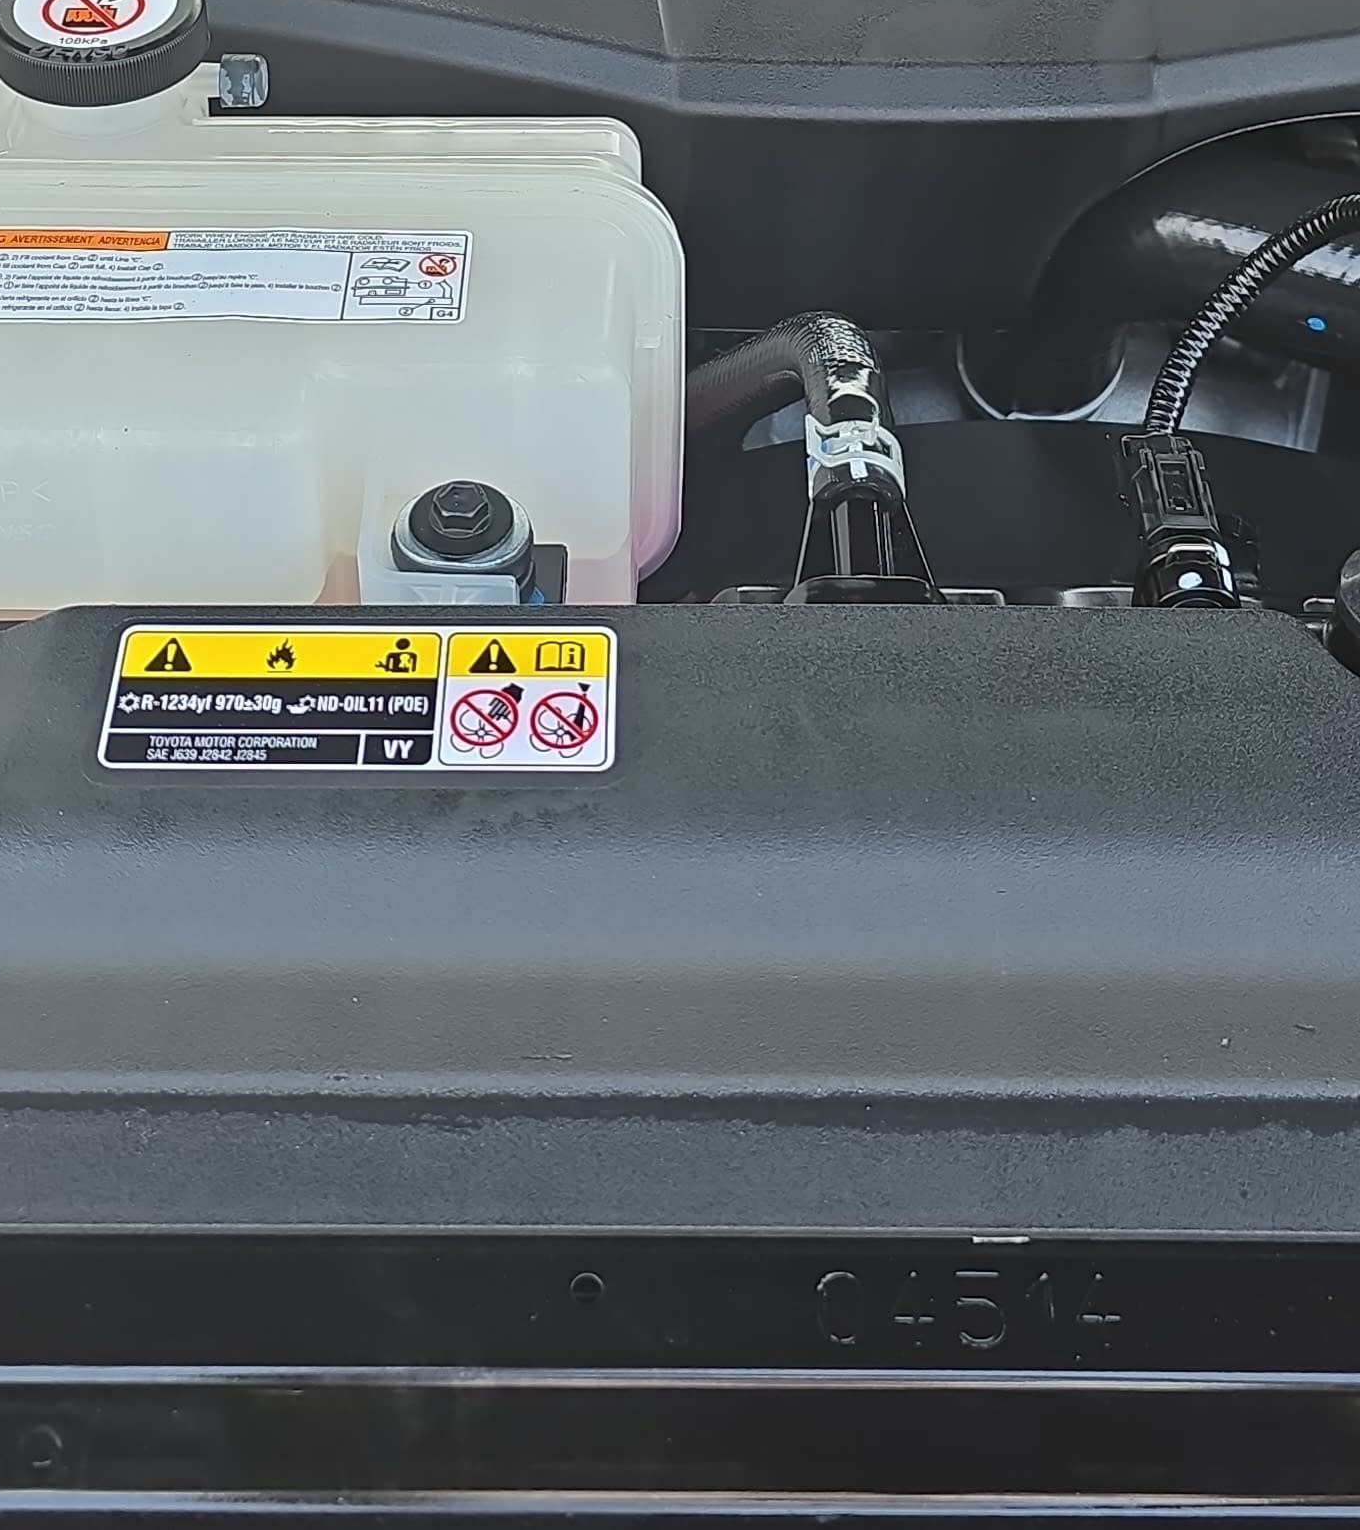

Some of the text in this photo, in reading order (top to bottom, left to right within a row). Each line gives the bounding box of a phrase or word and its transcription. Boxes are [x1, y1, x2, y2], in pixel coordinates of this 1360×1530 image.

[10, 234, 93, 244] AVERTISSEMENT
[98, 237, 160, 245] ADVERTENCIA
[141, 694, 211, 714] R-1234yf
[216, 695, 282, 714] 970±30g
[388, 696, 429, 715] (POE)
[150, 735, 318, 749] TOYOTA MOTOR CORPORATION
[383, 739, 414, 758] VY
[146, 748, 267, 761] SAE J639 J2842 J2845
